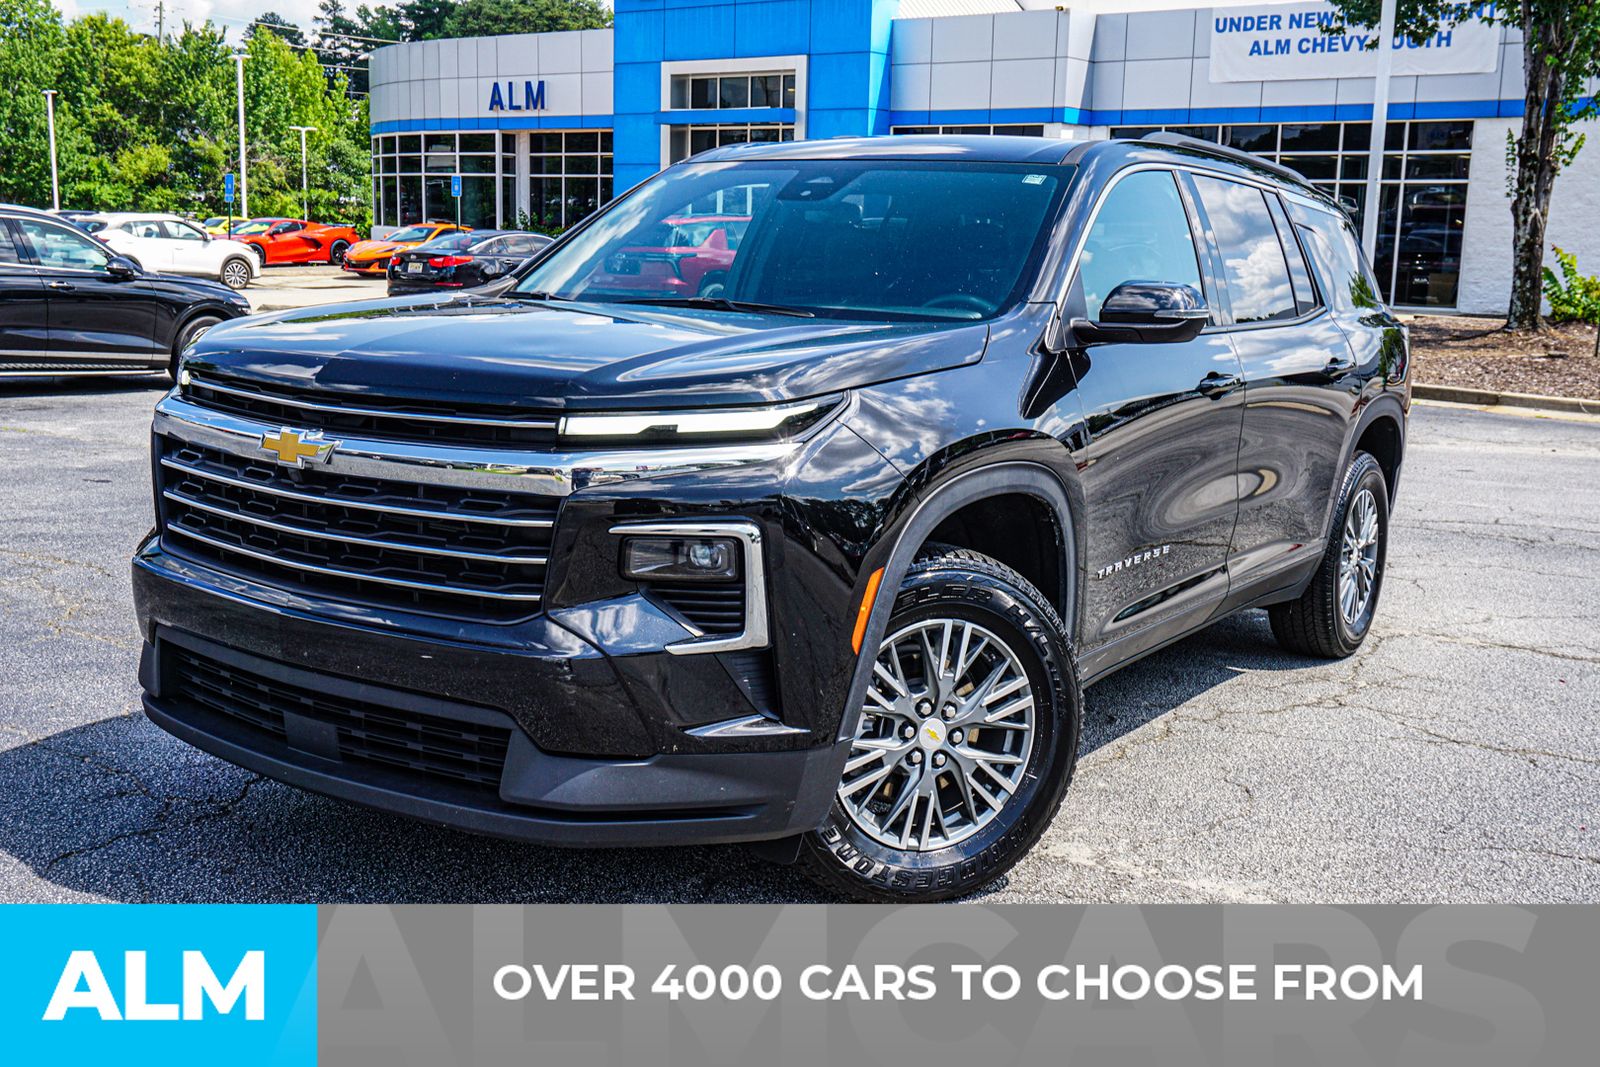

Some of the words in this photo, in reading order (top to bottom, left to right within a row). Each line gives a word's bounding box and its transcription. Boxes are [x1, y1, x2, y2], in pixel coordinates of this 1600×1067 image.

[1214, 14, 1282, 34] UNDER
[1288, 11, 1336, 30] NEW
[1248, 38, 1291, 57] ALM
[1297, 35, 1370, 54] CHEVY
[488, 80, 546, 112] ALM
[1096, 544, 1171, 580] TRAVERSE
